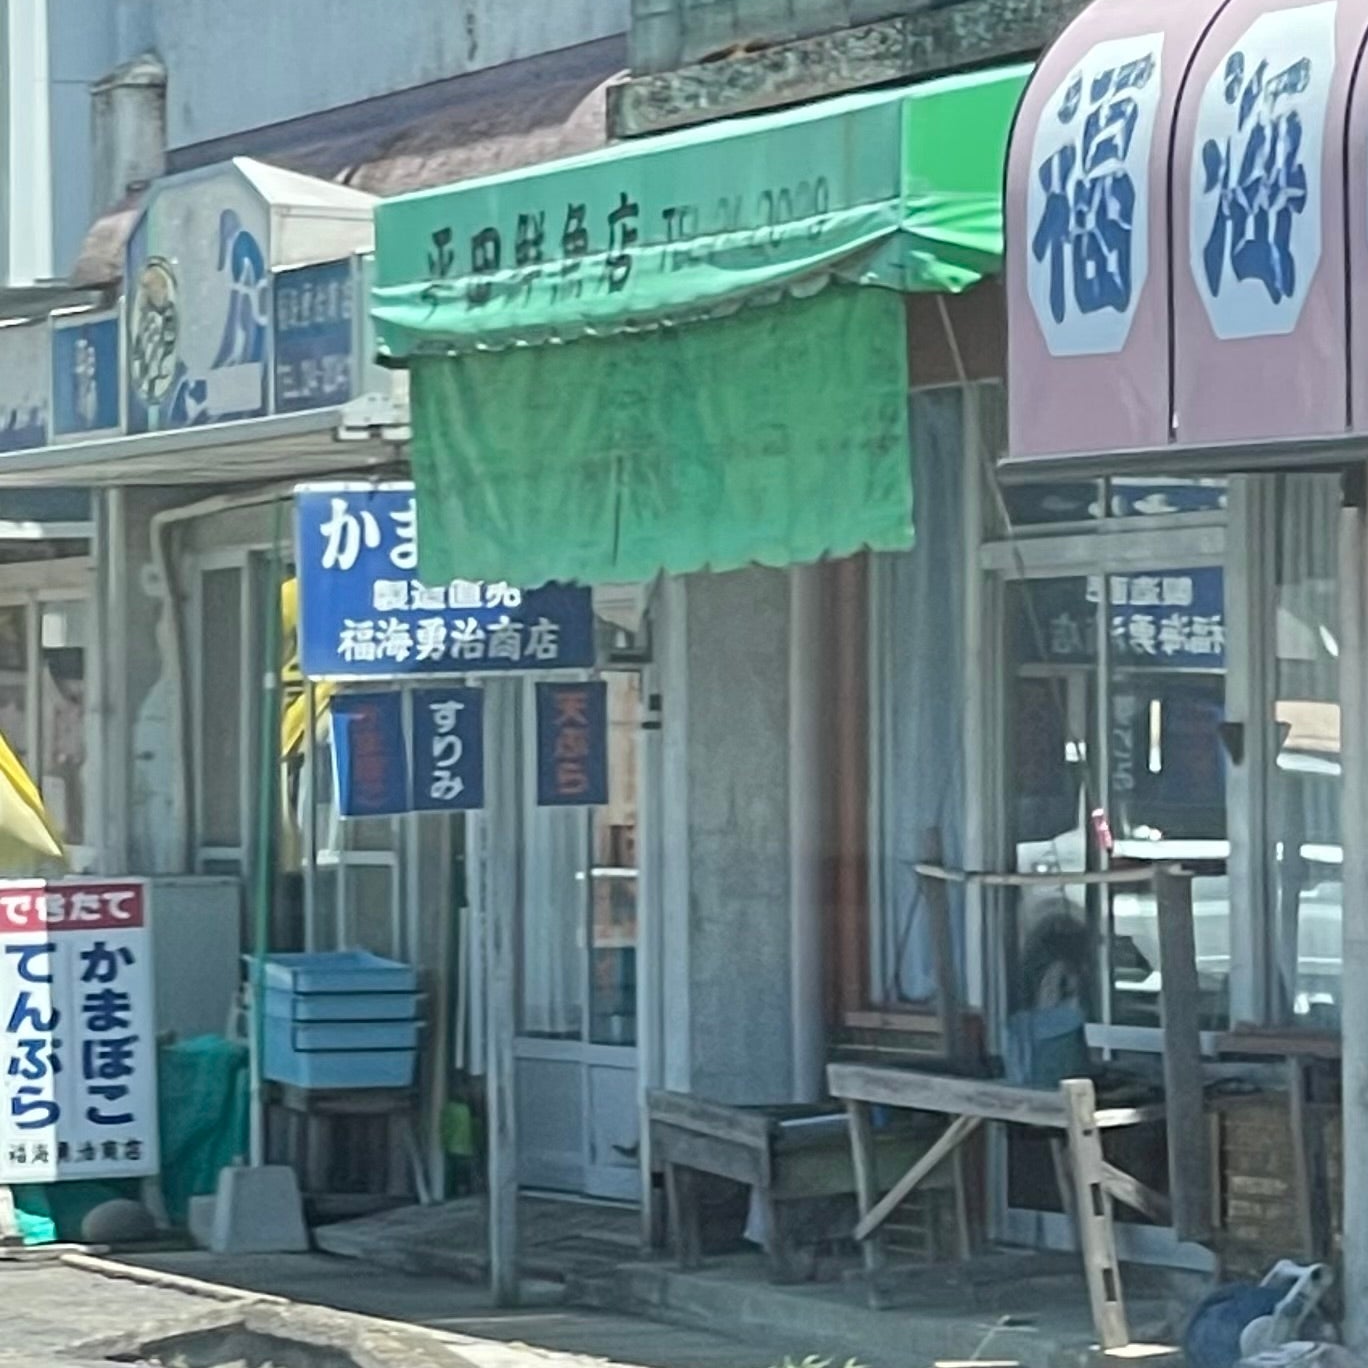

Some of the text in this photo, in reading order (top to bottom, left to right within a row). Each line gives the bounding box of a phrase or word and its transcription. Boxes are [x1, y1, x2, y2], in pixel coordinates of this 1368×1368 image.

[338, 616, 560, 662] 福海勇治商店
[429, 700, 465, 800] すりみ
[80, 942, 139, 1126] かまぼこ
